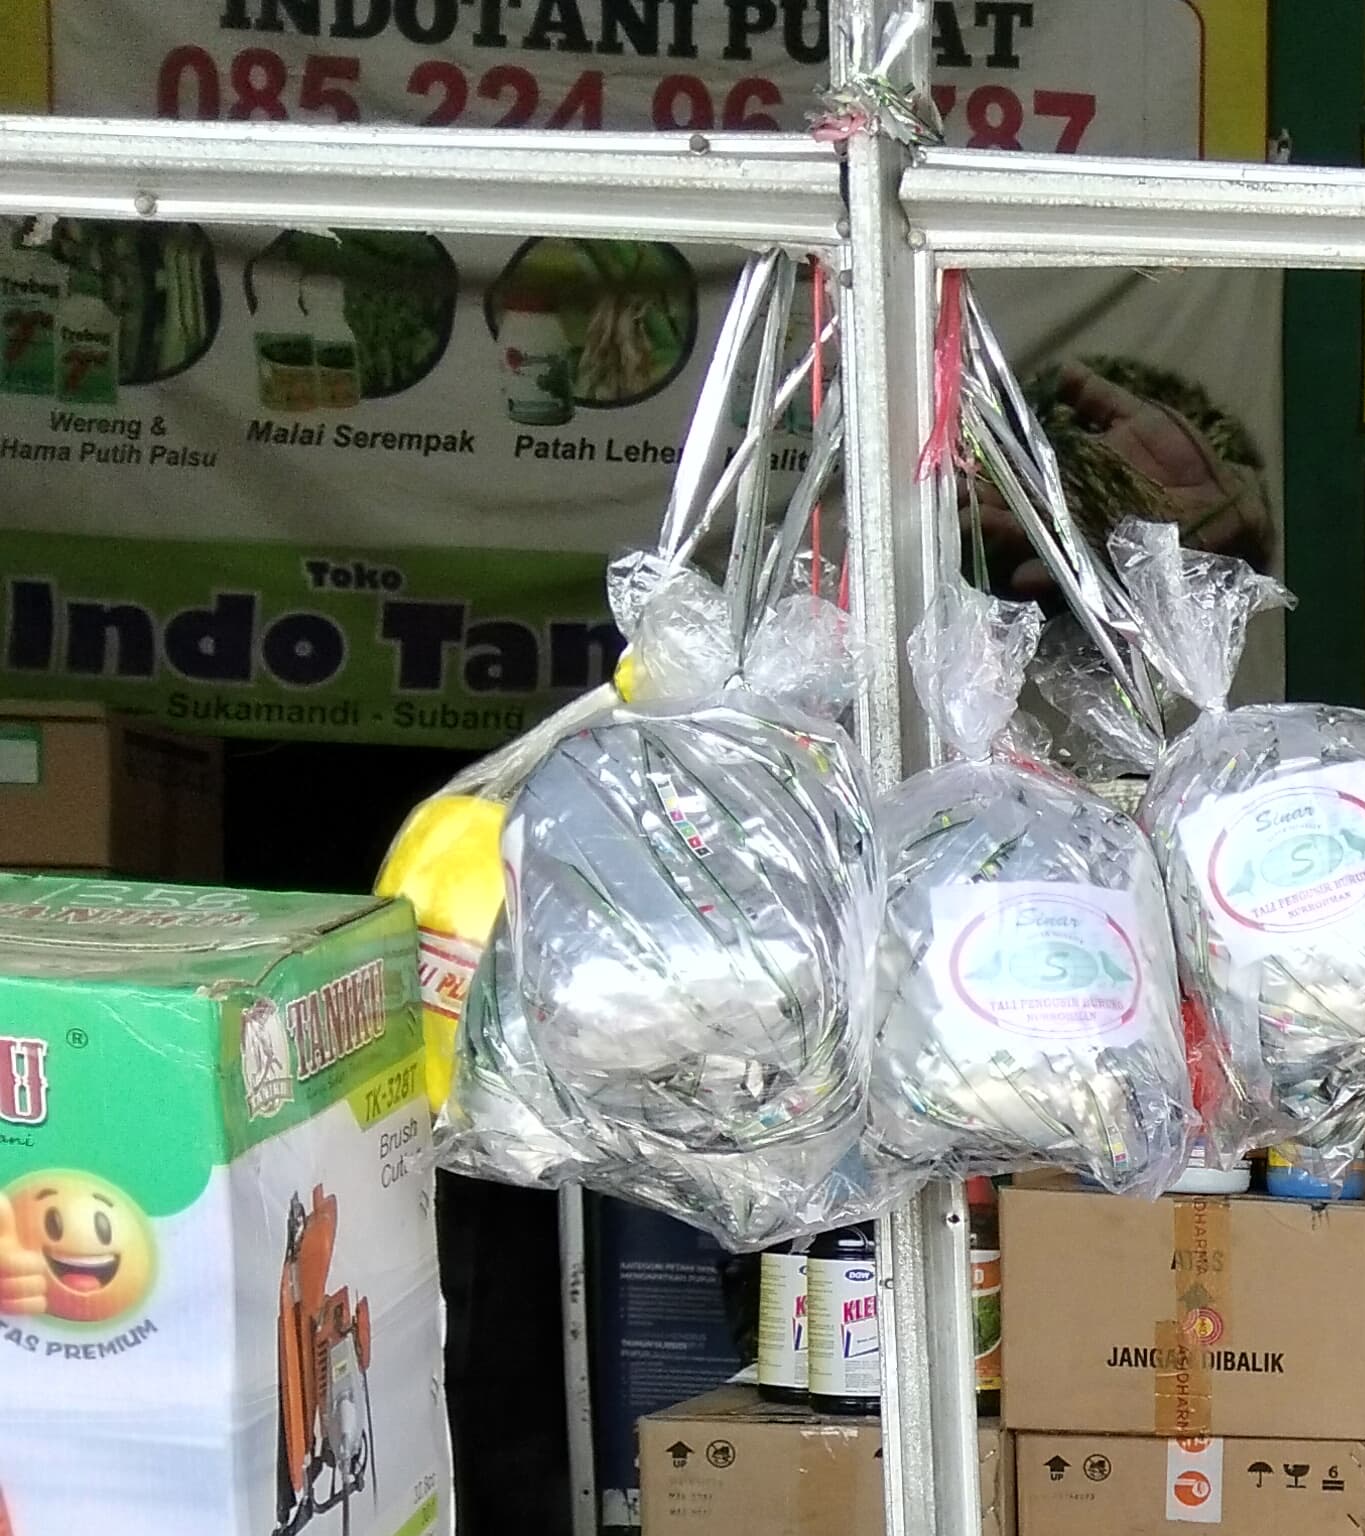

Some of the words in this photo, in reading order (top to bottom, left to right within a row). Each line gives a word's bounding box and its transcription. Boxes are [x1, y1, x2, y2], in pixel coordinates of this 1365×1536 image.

[156, 45, 361, 123] 085
[406, 60, 607, 131] 224
[50, 411, 142, 440] Wereng
[150, 416, 167, 437] &
[247, 420, 325, 448] Malai
[335, 424, 475, 458] Serempak
[1, 438, 71, 462] Hama
[80, 442, 141, 465] Putih
[149, 444, 218, 468] Palsu
[514, 437, 596, 463] Patah
[307, 559, 401, 591] Toko
[8, 579, 346, 688] Indo
[167, 693, 361, 727] Sukamandi
[393, 698, 524, 734] Subang
[379, 1120, 418, 1158] Brush
[46, 1319, 159, 1361] PREMIUM
[1199, 1349, 1285, 1374] DIBALIK
